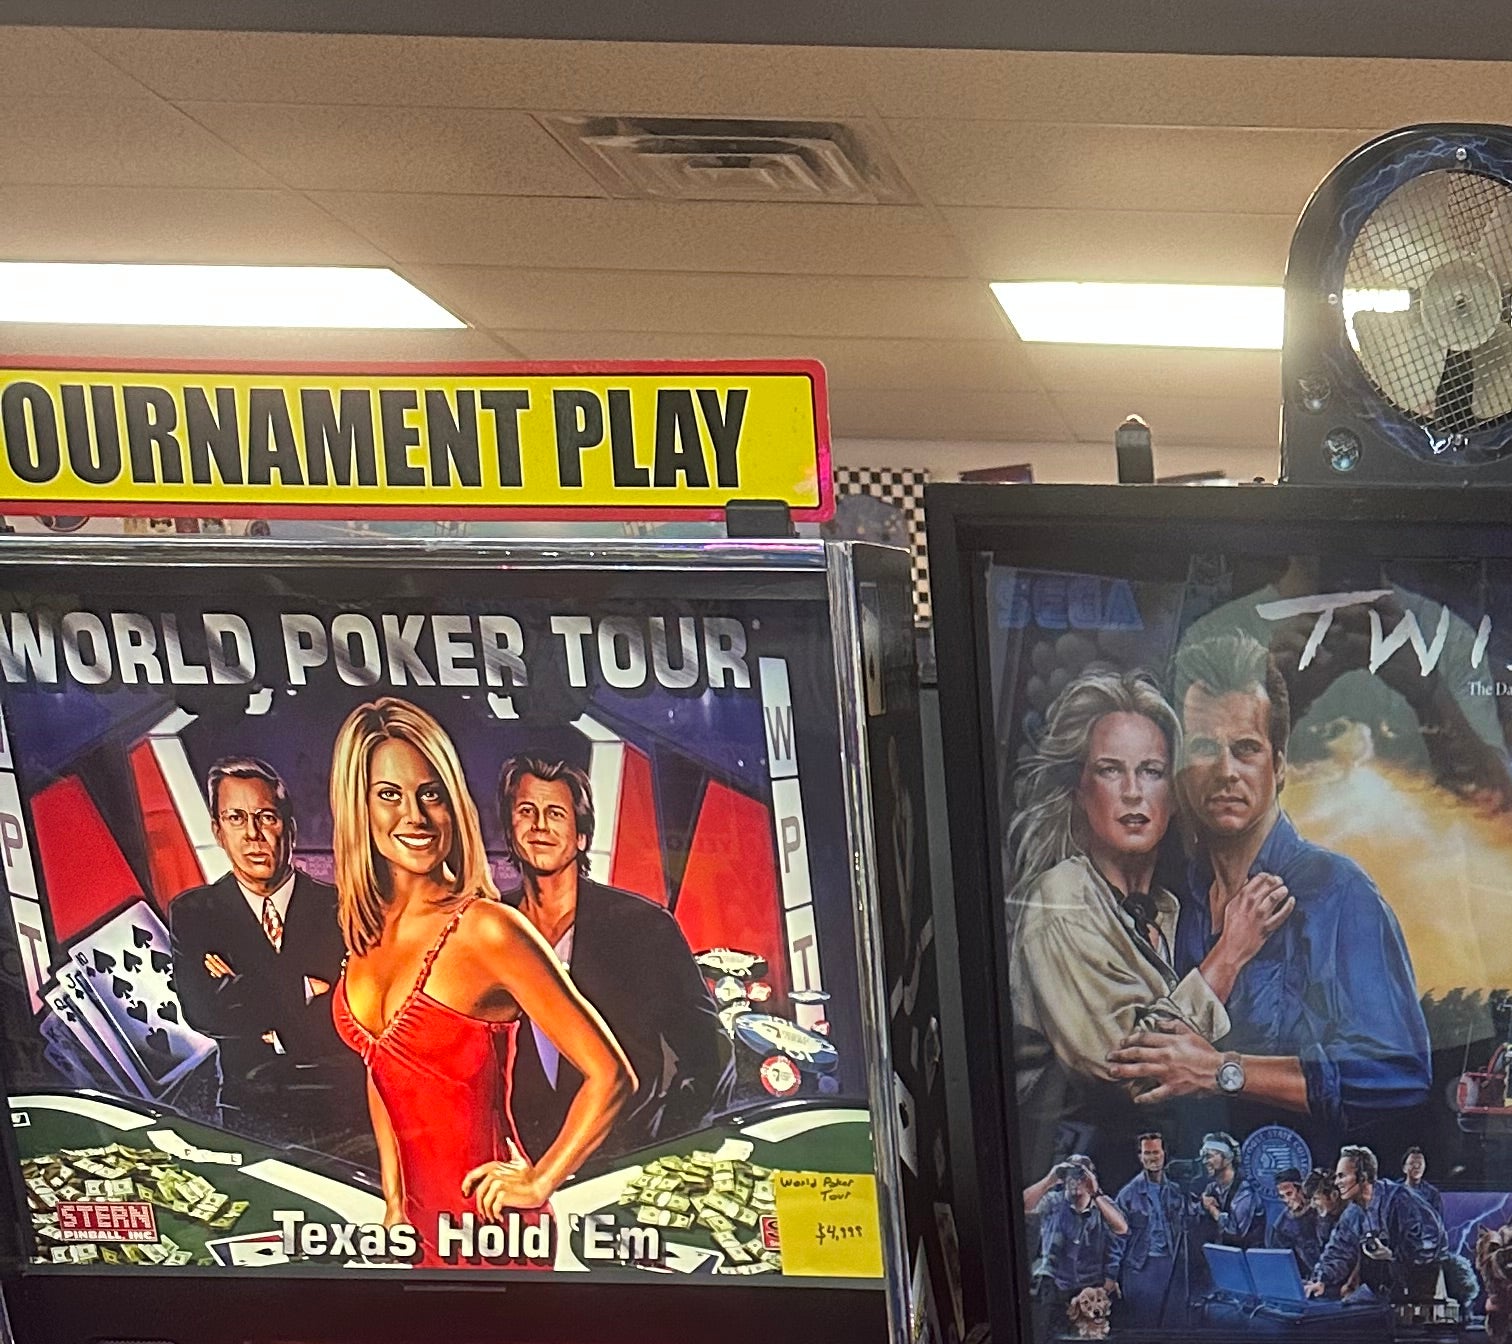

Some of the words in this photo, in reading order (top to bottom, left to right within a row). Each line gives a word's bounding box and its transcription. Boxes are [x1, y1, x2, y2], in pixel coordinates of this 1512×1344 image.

[552, 388, 749, 488] PLAY
[0, 611, 257, 686] WORLD
[281, 613, 528, 687] POKER
[551, 615, 751, 689] TOUR
[1468, 682, 1493, 697] The
[780, 1176, 818, 1189] World
[820, 1190, 852, 1201] Tour
[61, 1203, 154, 1230] STERN
[272, 1210, 418, 1258] Texas
[439, 1211, 550, 1260] Hold
